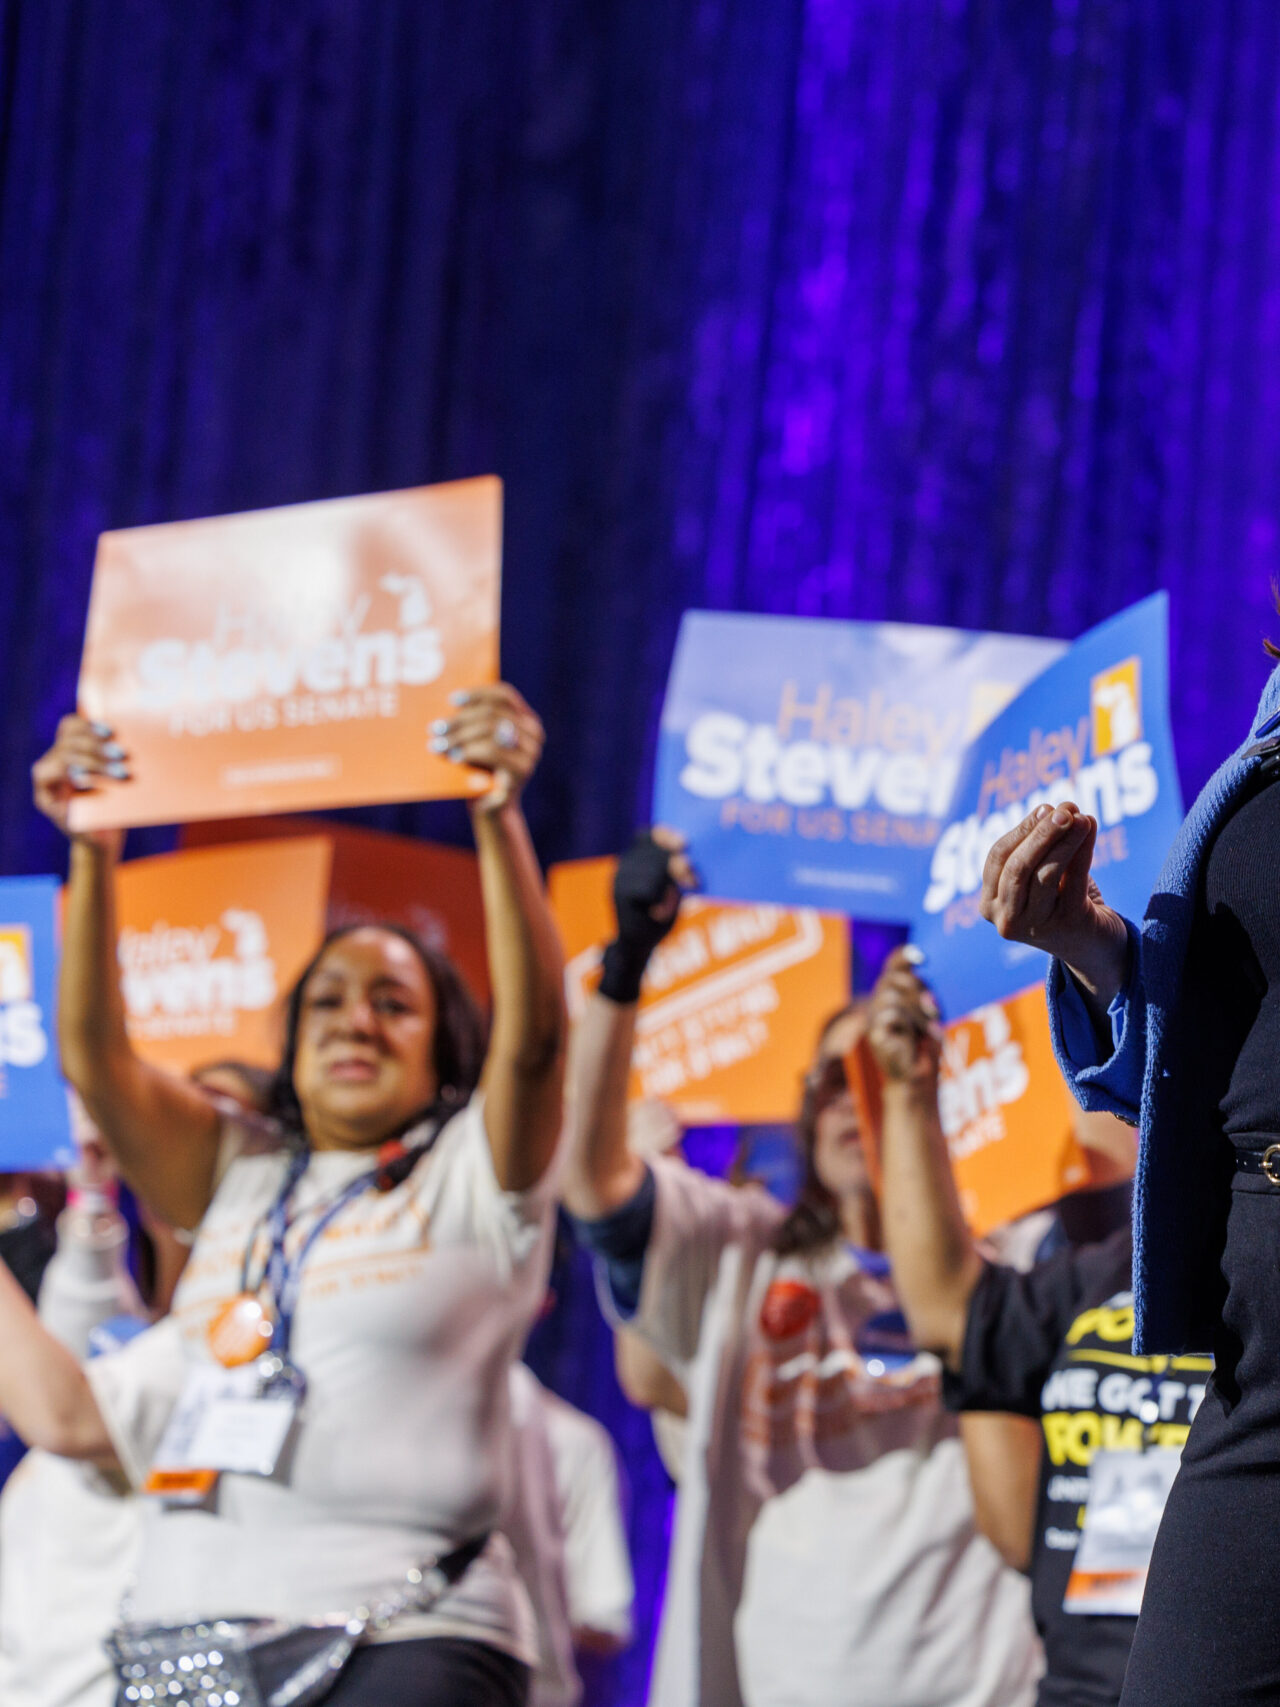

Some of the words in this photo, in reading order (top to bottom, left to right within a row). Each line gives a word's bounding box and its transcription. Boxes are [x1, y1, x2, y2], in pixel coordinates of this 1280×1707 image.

[136, 628, 444, 713] Stevens
[679, 711, 957, 819] Steve
[776, 679, 962, 768] Haley
